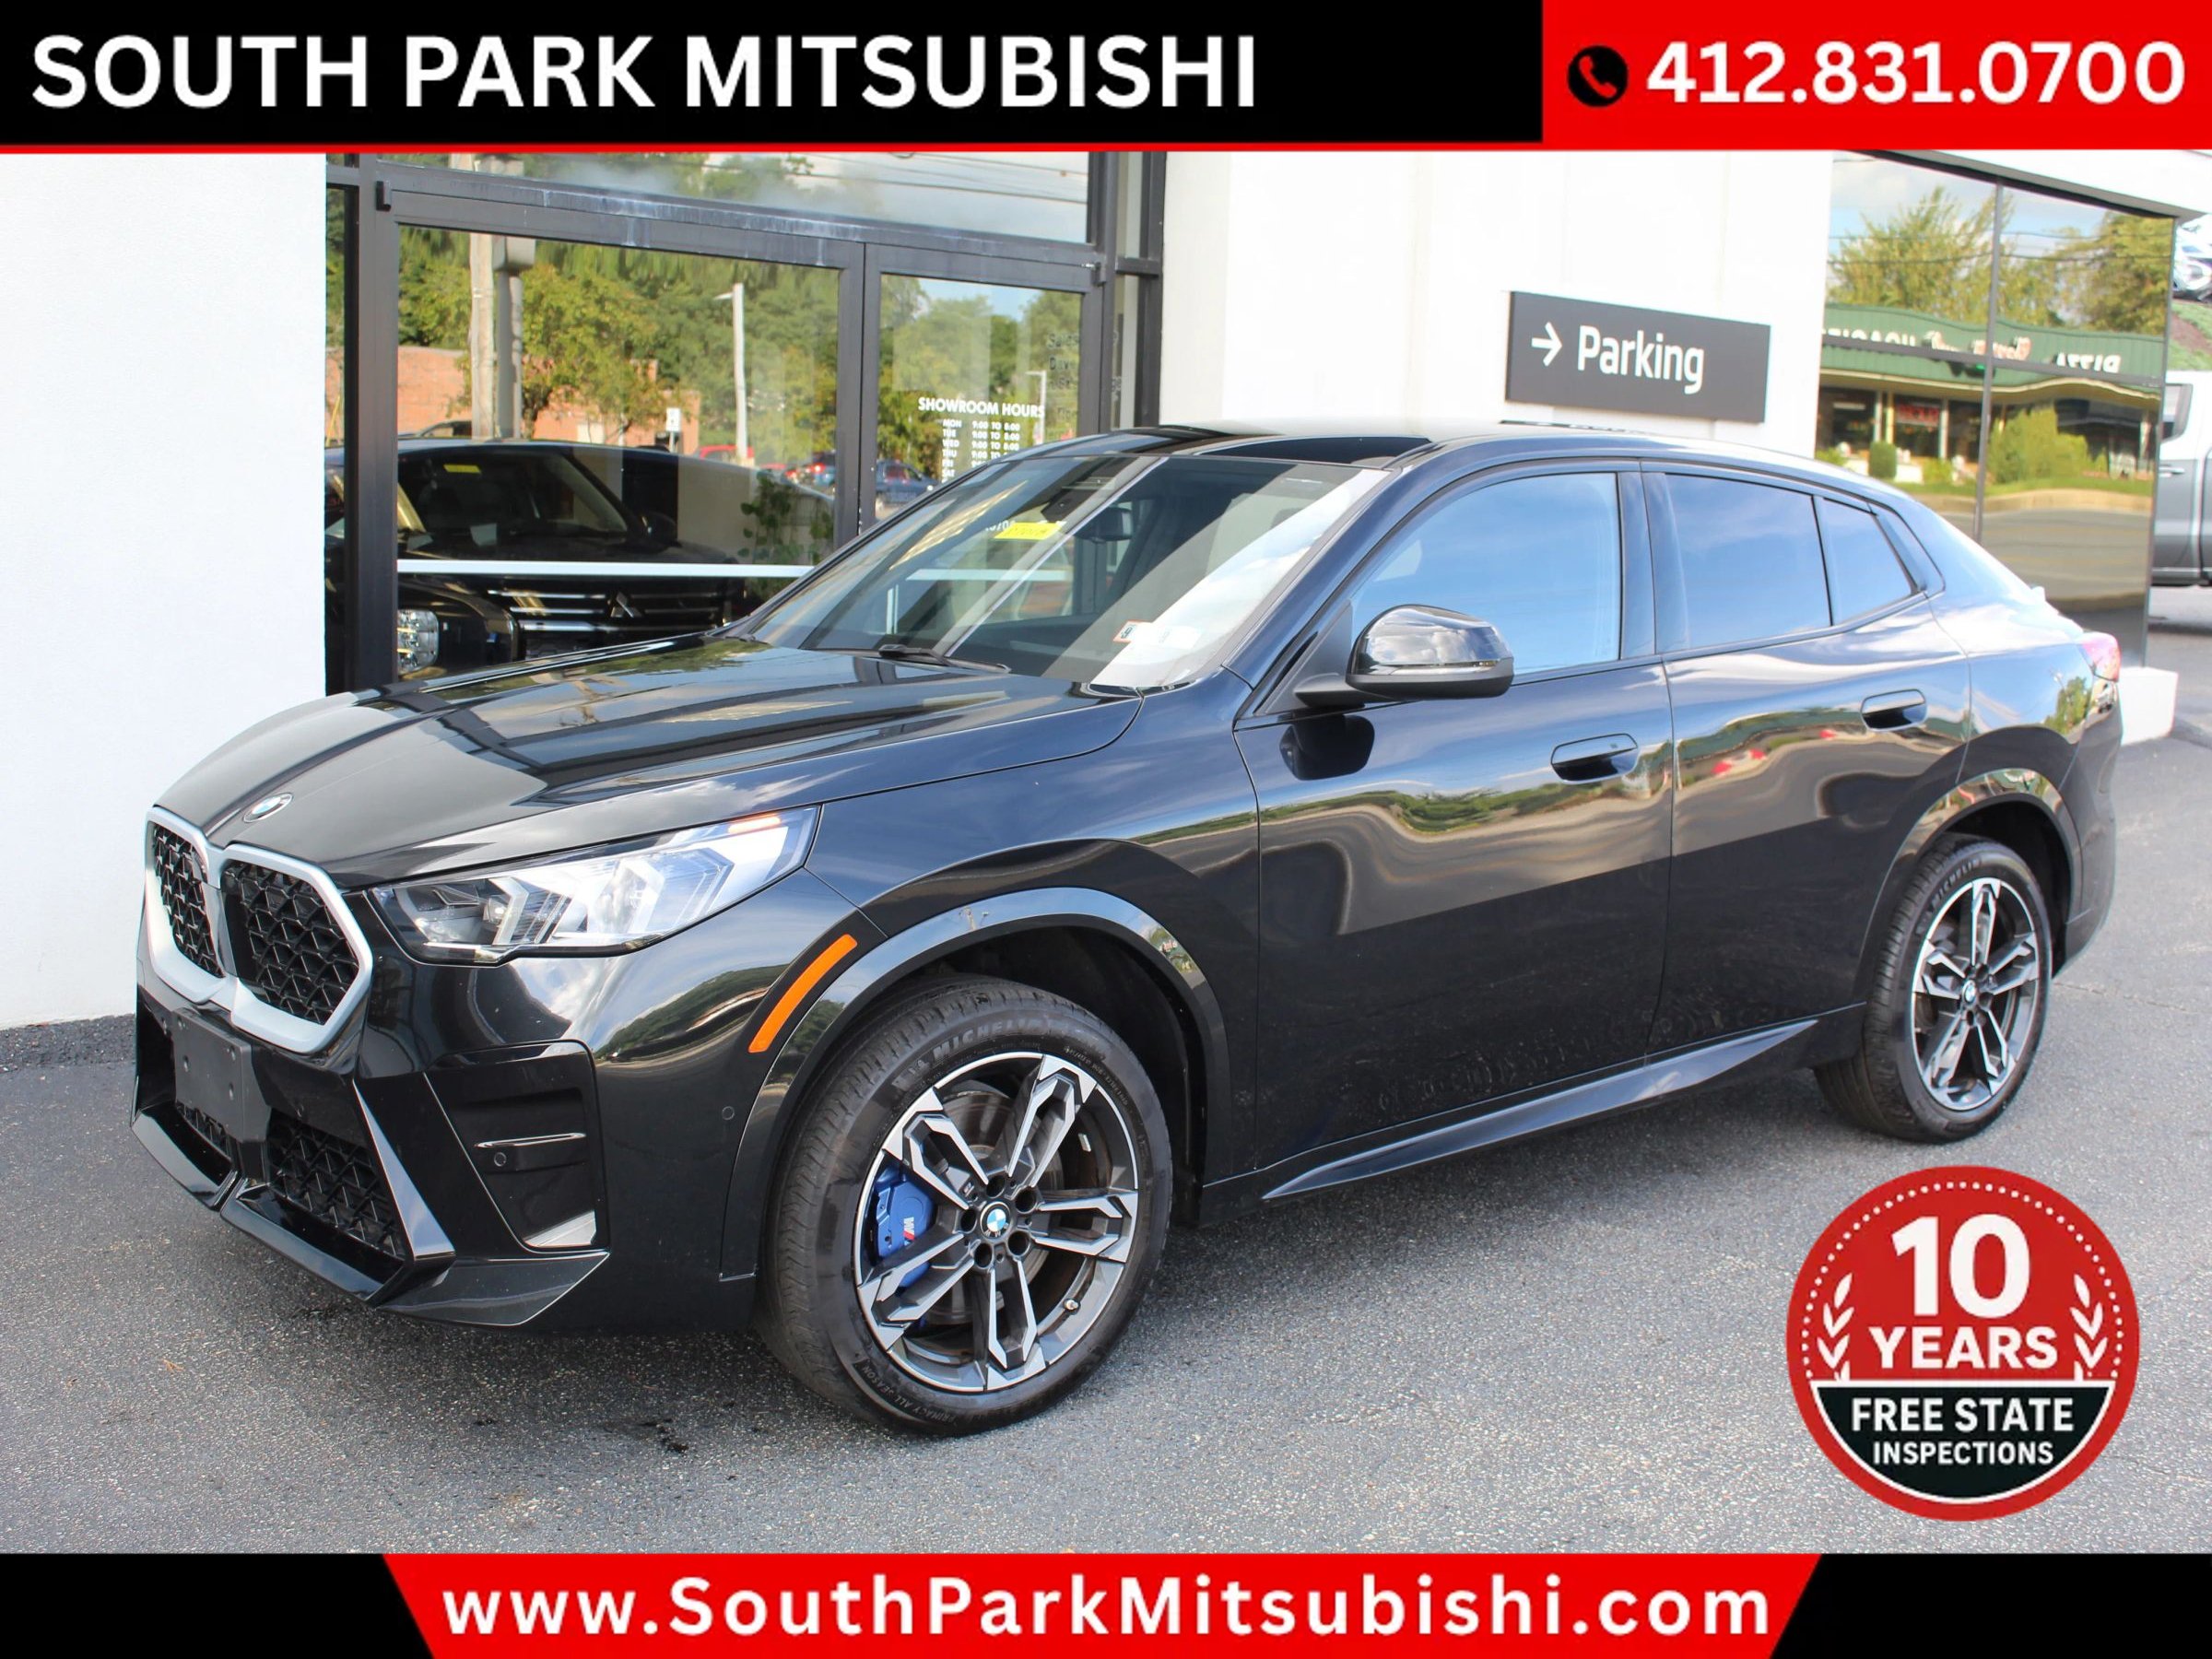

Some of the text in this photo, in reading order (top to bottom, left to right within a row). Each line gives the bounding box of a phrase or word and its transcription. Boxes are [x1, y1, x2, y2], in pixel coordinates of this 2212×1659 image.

[1578, 325, 1704, 394] Parking
[918, 397, 1044, 418] SHOWROOM HOURS
[942, 418, 962, 429] MON
[991, 421, 1002, 430] TO
[942, 429, 957, 438] TUE
[990, 431, 1001, 441] TO
[942, 439, 959, 448] WED
[990, 441, 1001, 451] TO
[861, 1366, 895, 1396] SEASON
[893, 1394, 914, 1409] ALL
